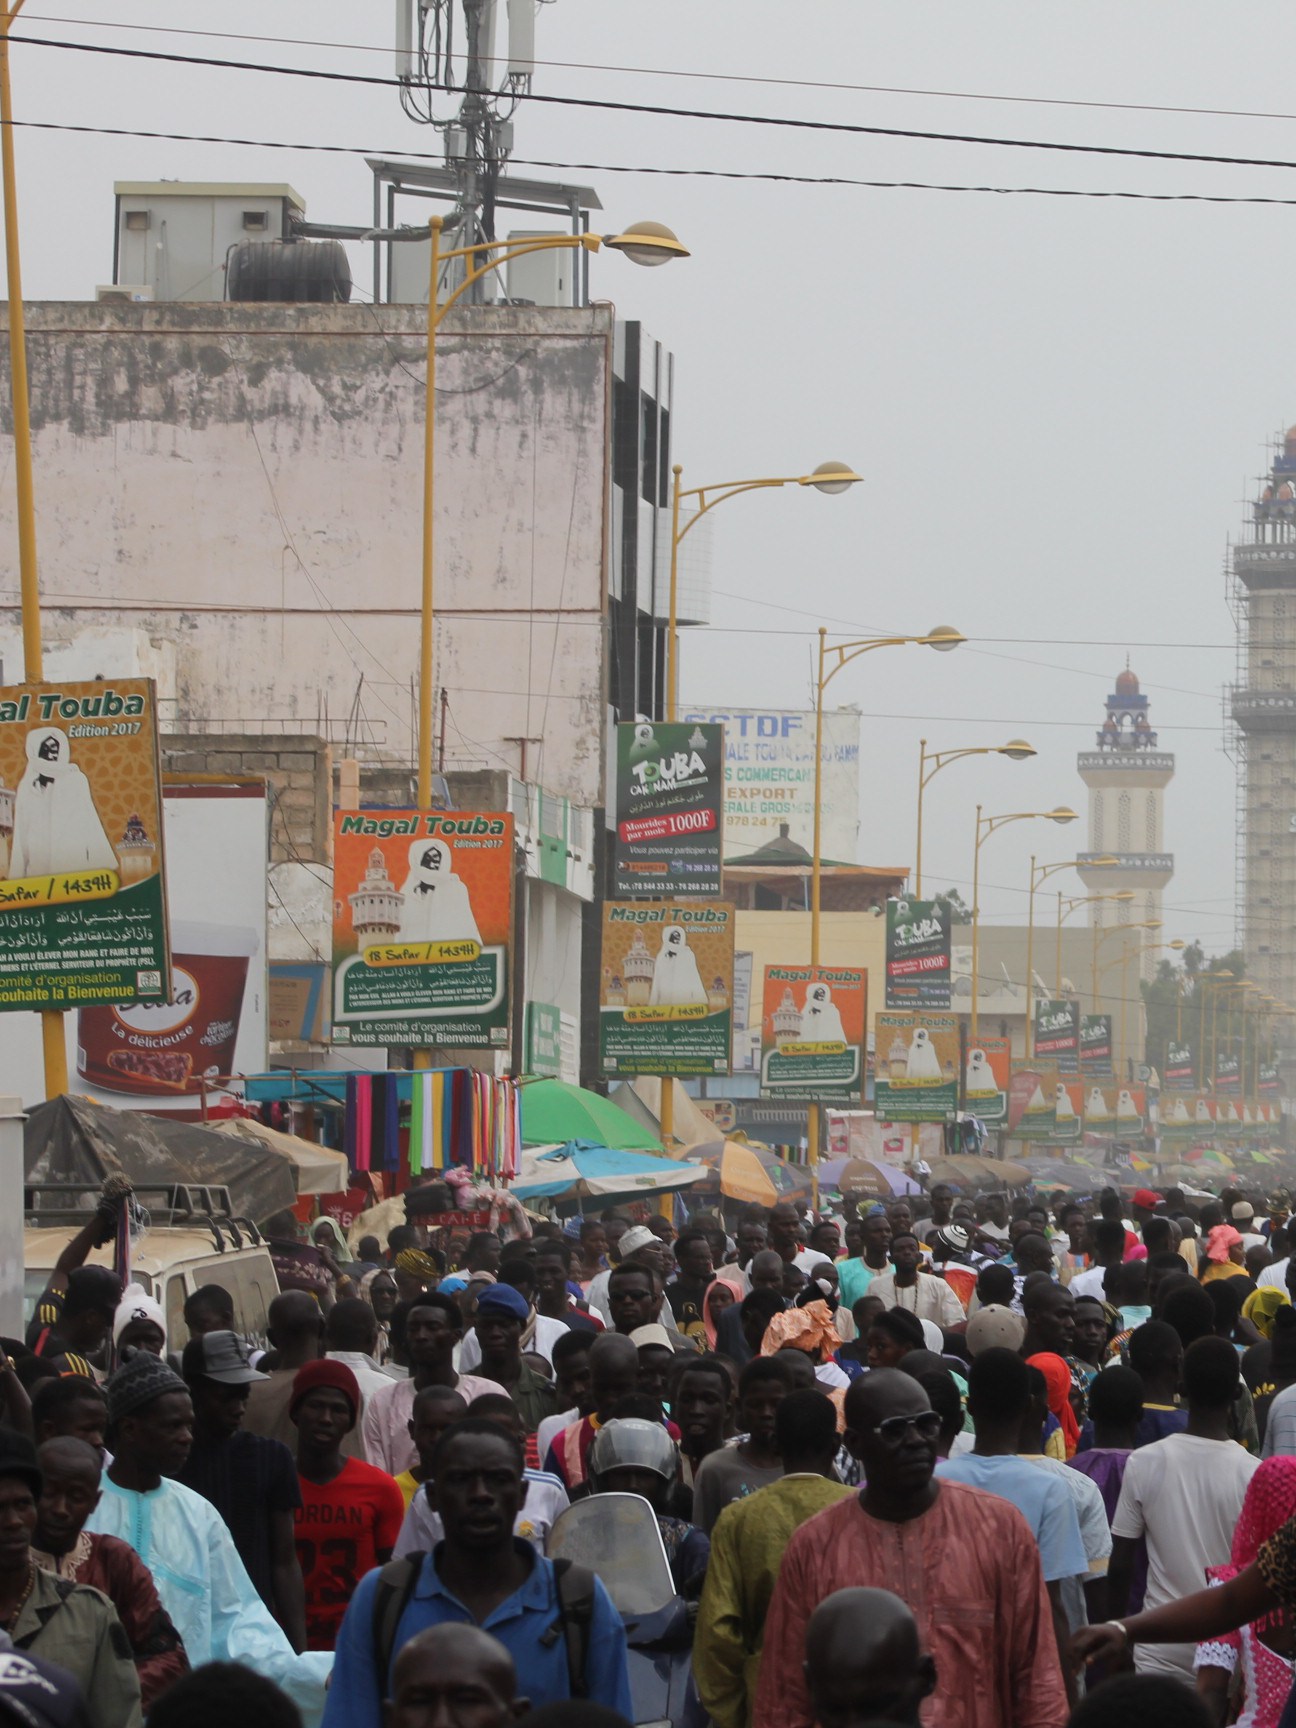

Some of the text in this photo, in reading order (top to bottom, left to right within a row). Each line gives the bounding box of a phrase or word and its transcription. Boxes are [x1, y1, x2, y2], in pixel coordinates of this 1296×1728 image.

[38, 690, 145, 720] Touba
[68, 722, 141, 738] Edition 2017
[632, 751, 706, 784] TOUBA
[728, 788, 798, 799] EXPORT
[339, 815, 505, 838] Magal Touba
[626, 819, 667, 832] Mourides
[669, 810, 710, 833] 1000F
[627, 828, 665, 841] par mois
[453, 839, 503, 849] Edition 2017
[0, 887, 39, 902] Safar
[63, 874, 113, 895] 1439H
[609, 908, 728, 924] Magal Touba
[895, 918, 942, 939] TOUBA
[368, 950, 381, 961] 18
[386, 950, 420, 961] Safar
[438, 944, 475, 957] 1439H
[36, 971, 122, 988] d'organisation
[768, 968, 861, 982] Magal Touba
[52, 986, 64, 999] la
[68, 985, 135, 999] Bienvenue
[111, 1022, 126, 1039] La
[128, 1024, 195, 1048] délicieuse
[359, 1021, 482, 1035] Le comité d'organisation
[352, 1032, 489, 1044] vous souhaite la Bienvenue
[294, 1504, 362, 1525] ORDAN
